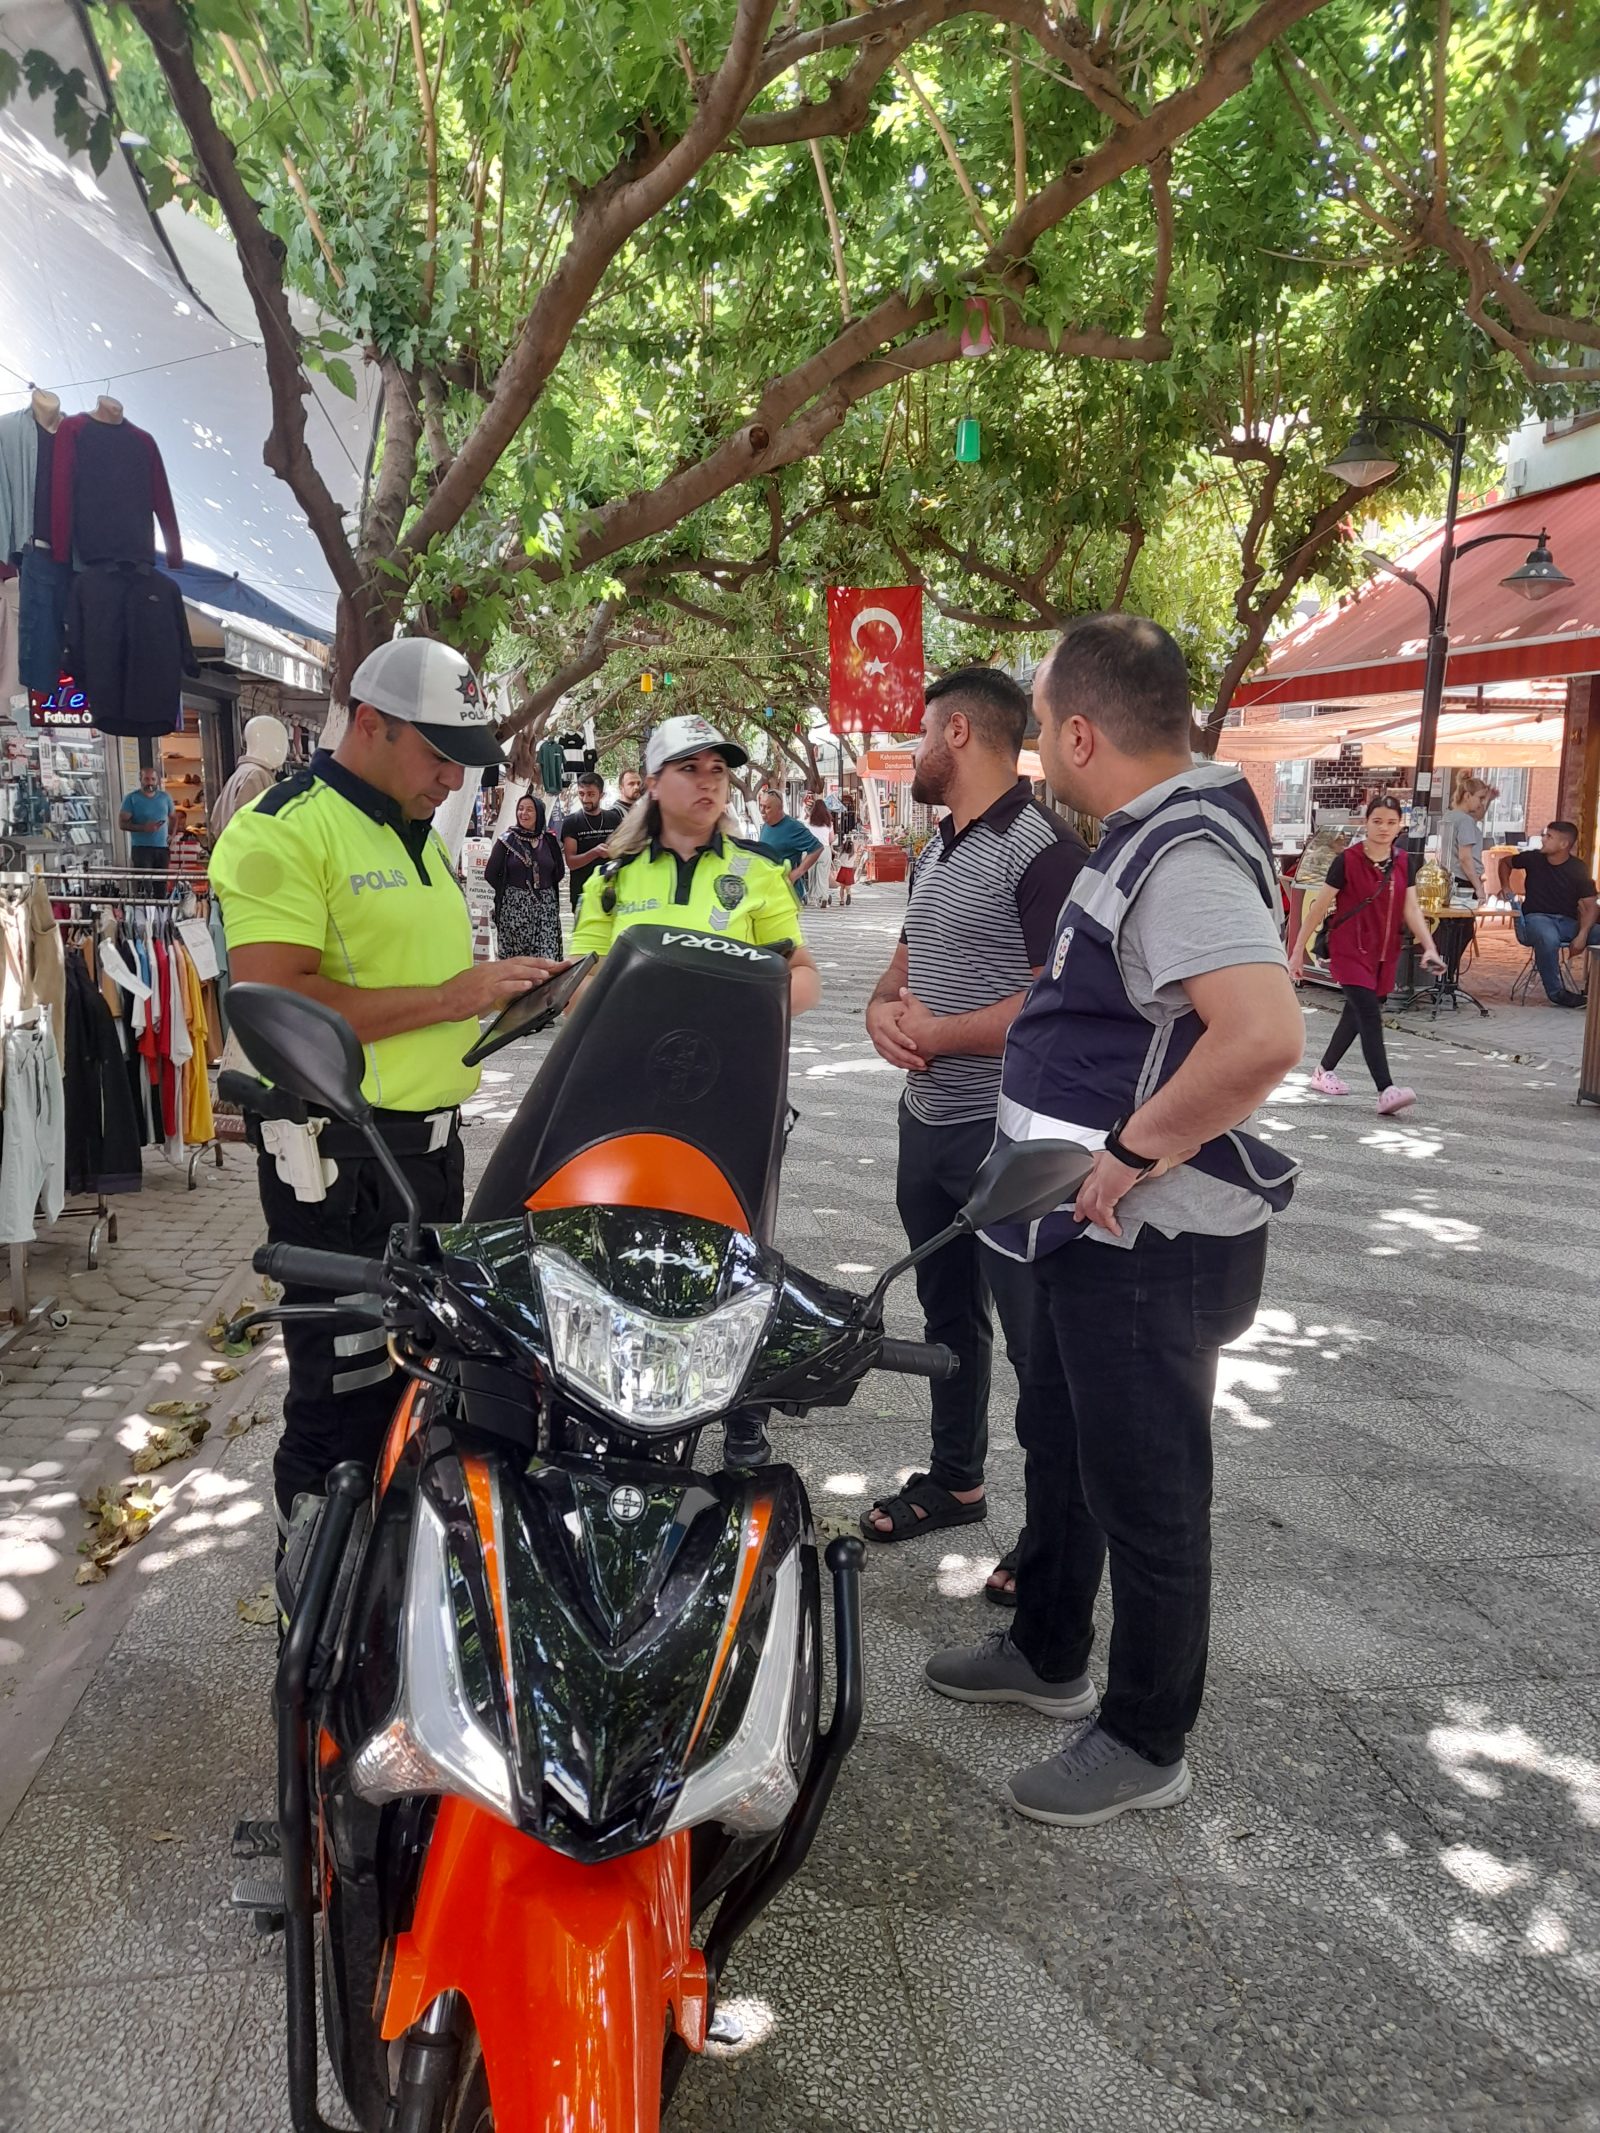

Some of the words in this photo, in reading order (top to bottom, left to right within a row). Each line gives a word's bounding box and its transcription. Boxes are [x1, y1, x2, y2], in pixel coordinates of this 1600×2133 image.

[44, 710, 81, 724] Fatura
[476, 858, 487, 866] BE
[661, 932, 773, 962] ARORA
